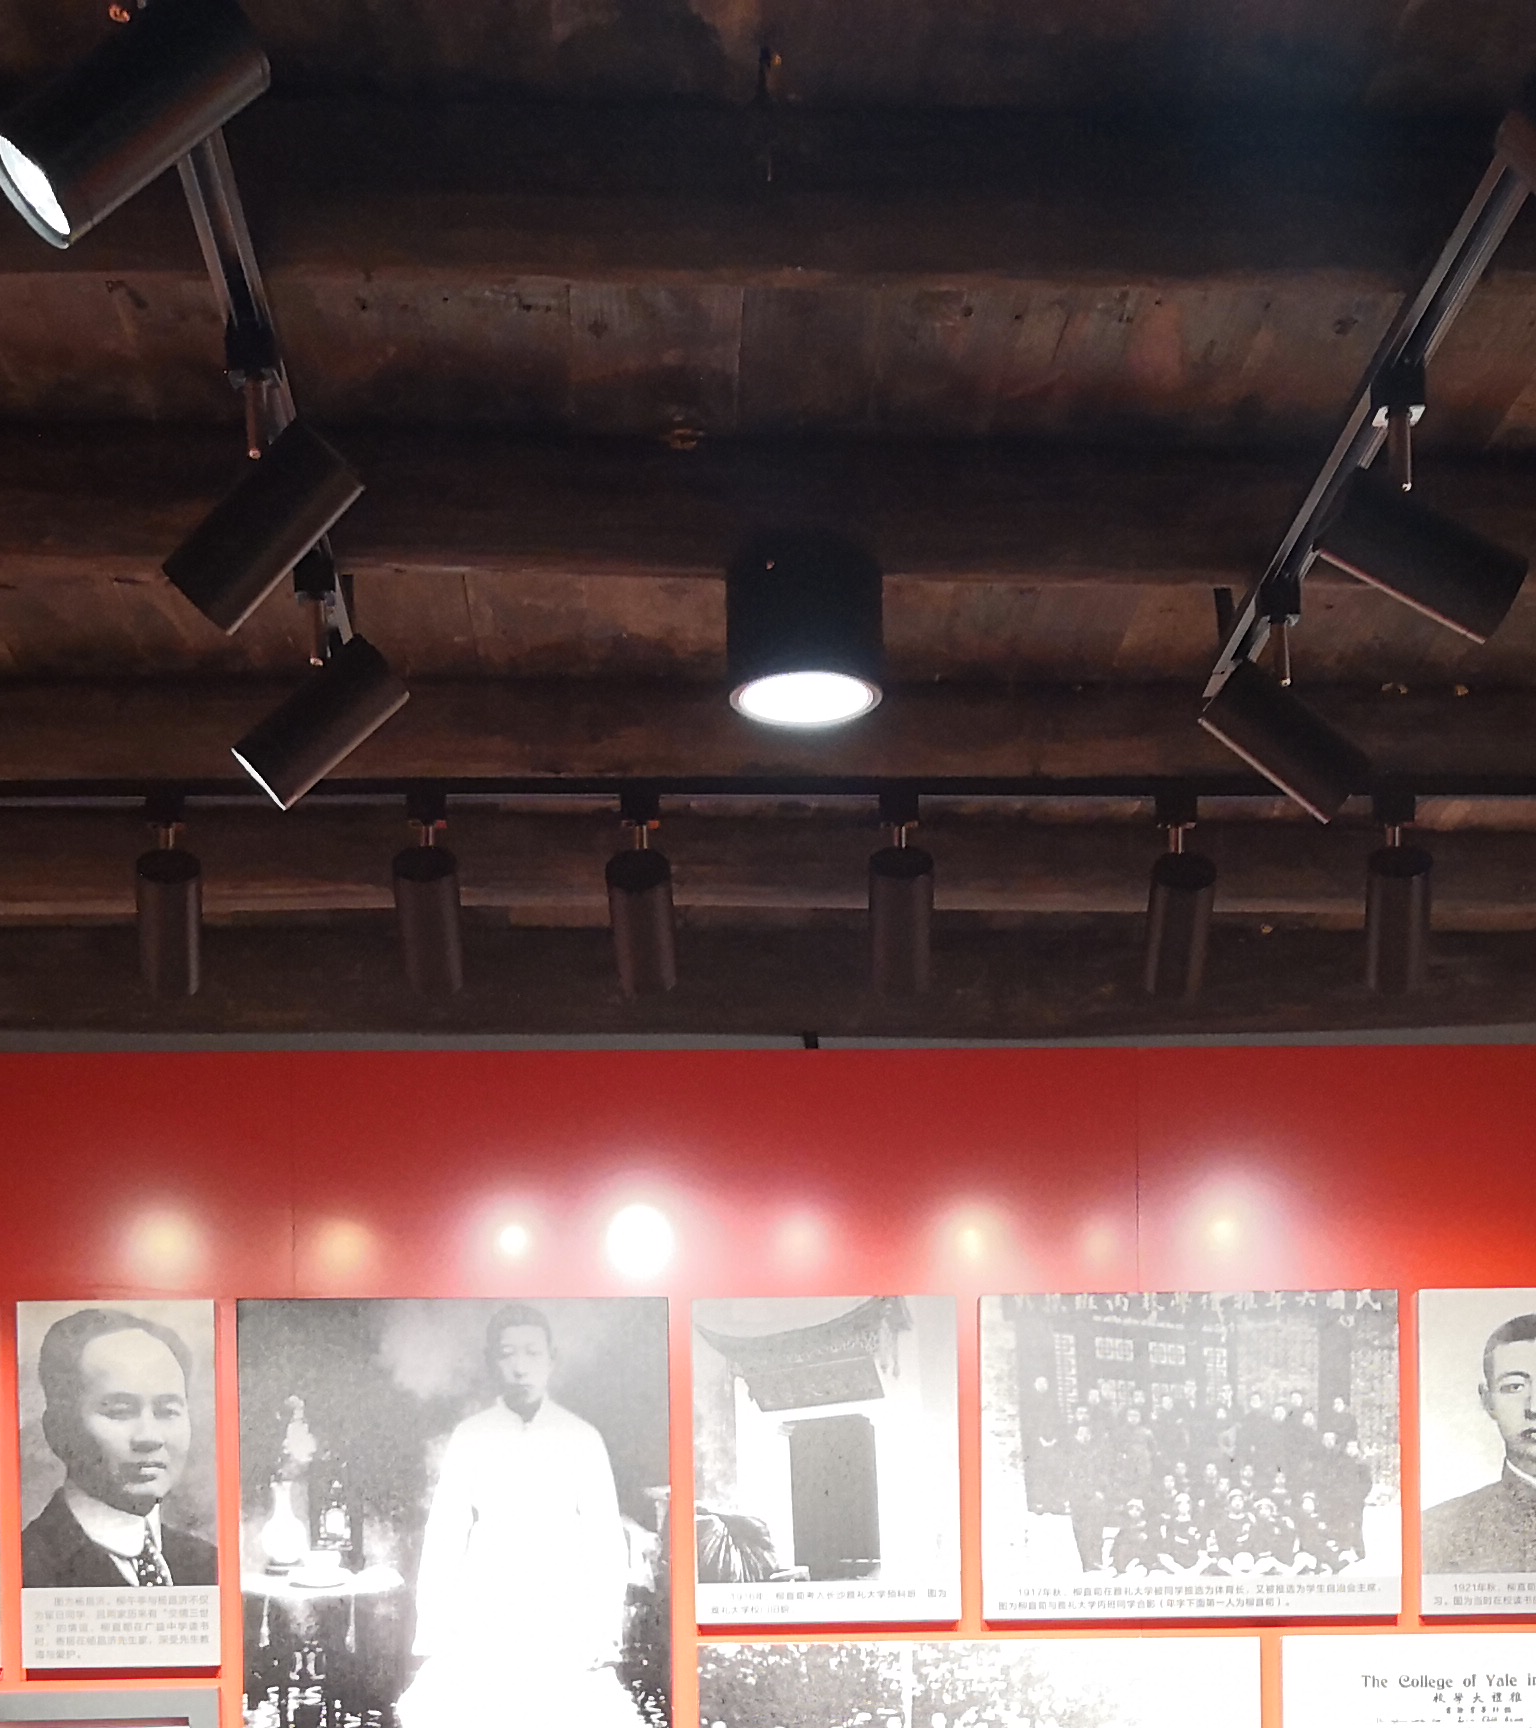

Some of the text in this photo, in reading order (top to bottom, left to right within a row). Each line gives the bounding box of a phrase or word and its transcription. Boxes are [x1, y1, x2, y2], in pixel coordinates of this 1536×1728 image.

[1362, 1674, 1388, 1688] The
[1399, 1673, 1454, 1690] College
[1462, 1673, 1477, 1688] of
[1485, 1673, 1518, 1687] Yale
